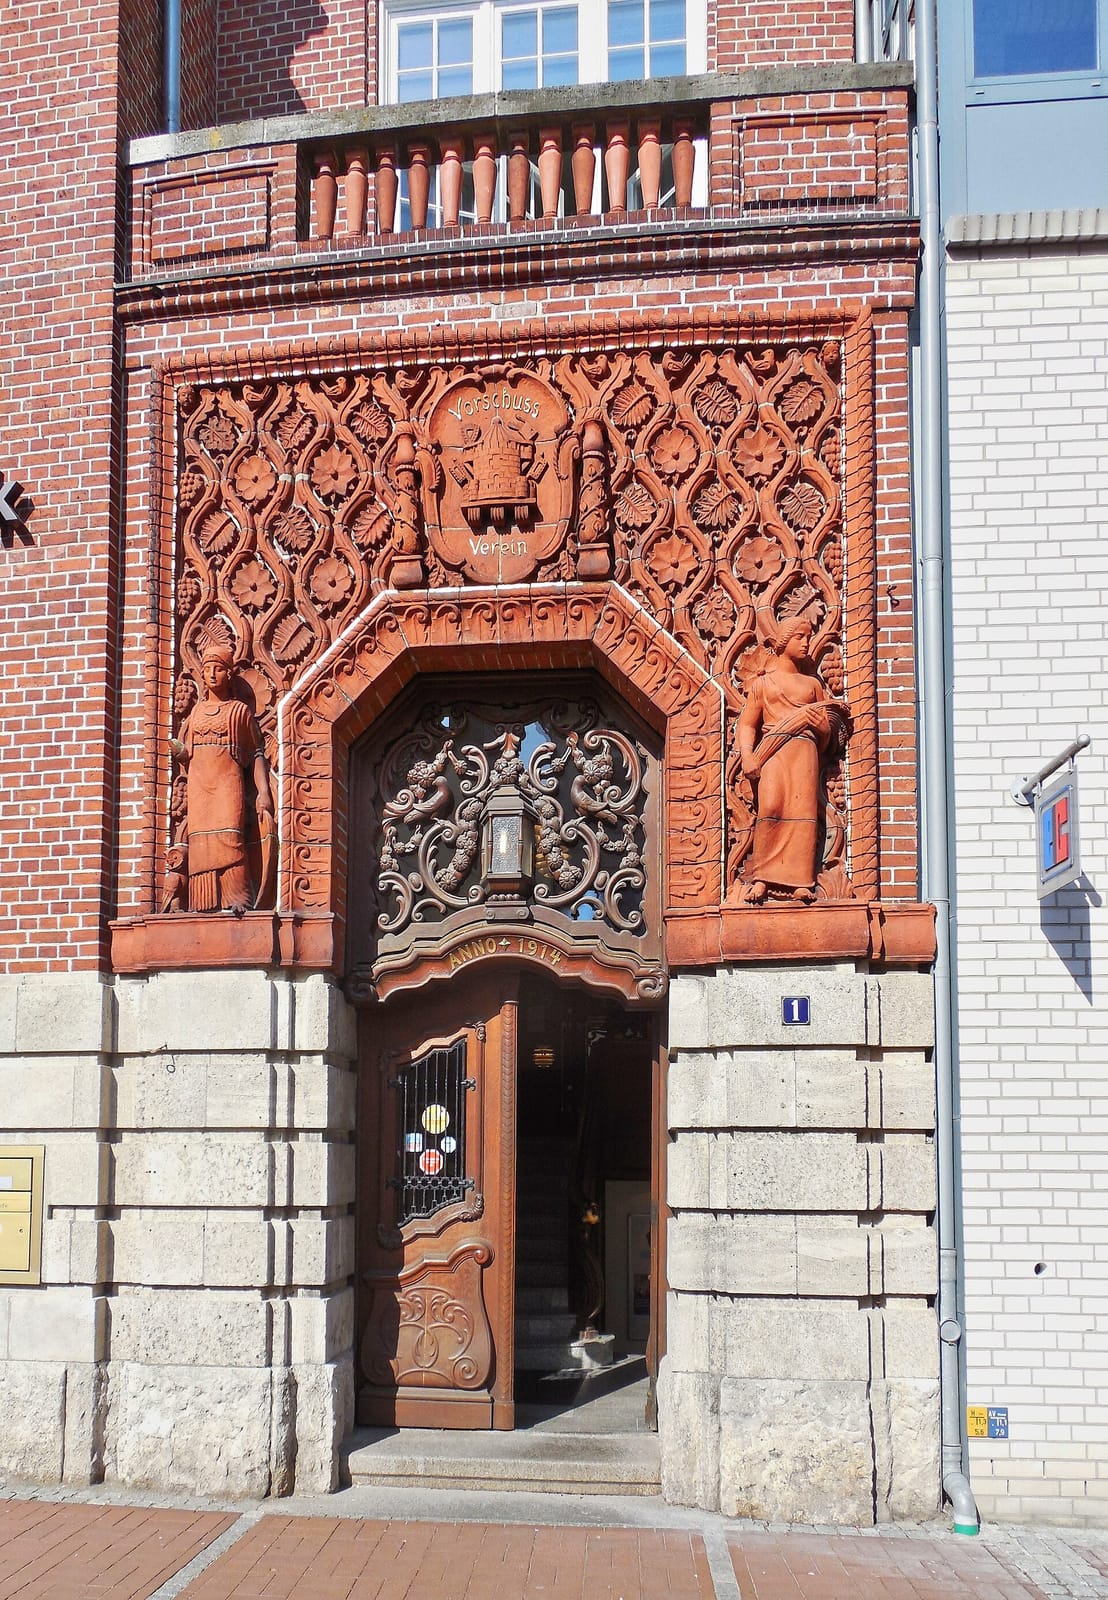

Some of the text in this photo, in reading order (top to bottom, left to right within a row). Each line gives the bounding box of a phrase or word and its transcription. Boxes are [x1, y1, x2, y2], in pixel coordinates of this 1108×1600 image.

[447, 386, 542, 421] Vorschuss
[468, 535, 528, 557] Verein
[449, 937, 562, 969] ANNO 1914
[791, 999, 801, 1022] 1
